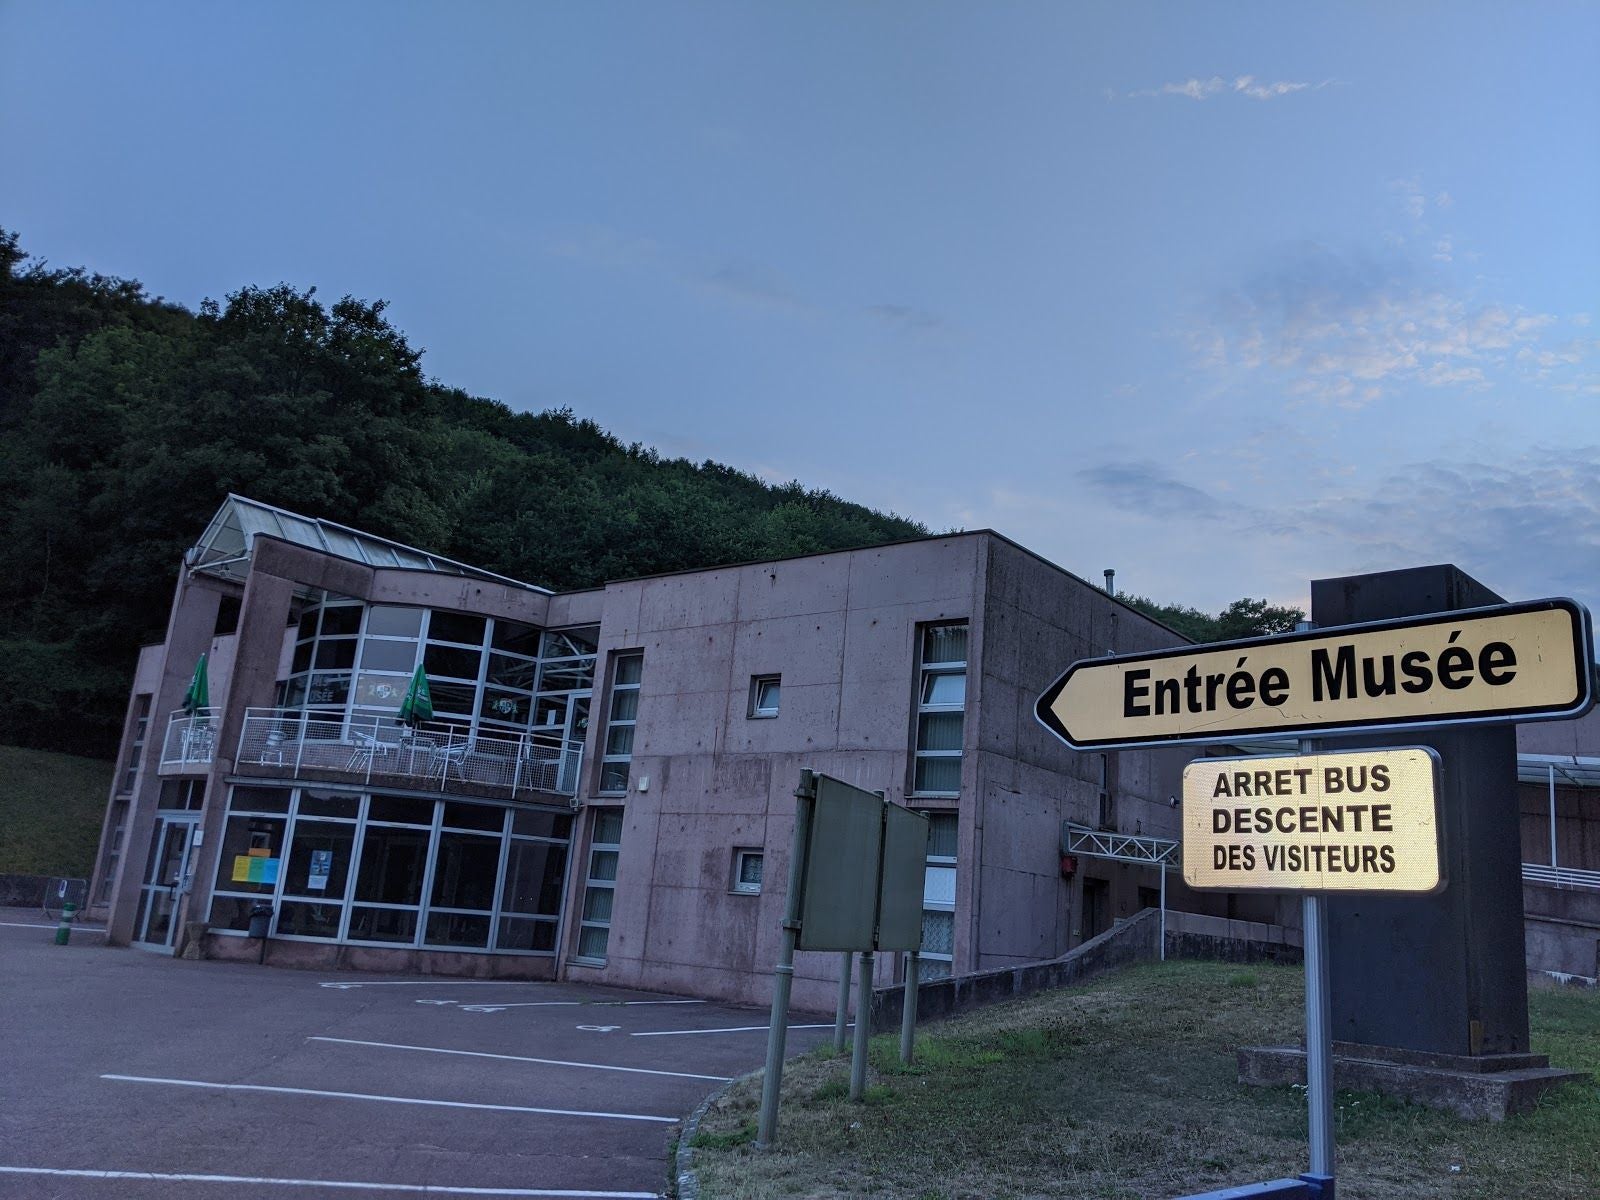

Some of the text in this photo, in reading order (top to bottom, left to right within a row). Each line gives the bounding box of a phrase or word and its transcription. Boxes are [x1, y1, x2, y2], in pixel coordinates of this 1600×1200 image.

[1123, 630, 1517, 718] Entrée Musée
[1212, 764, 1391, 798] ARRET BUS
[1212, 803, 1394, 834] DESCENTE
[1213, 844, 1396, 874] DES VISITEURS
